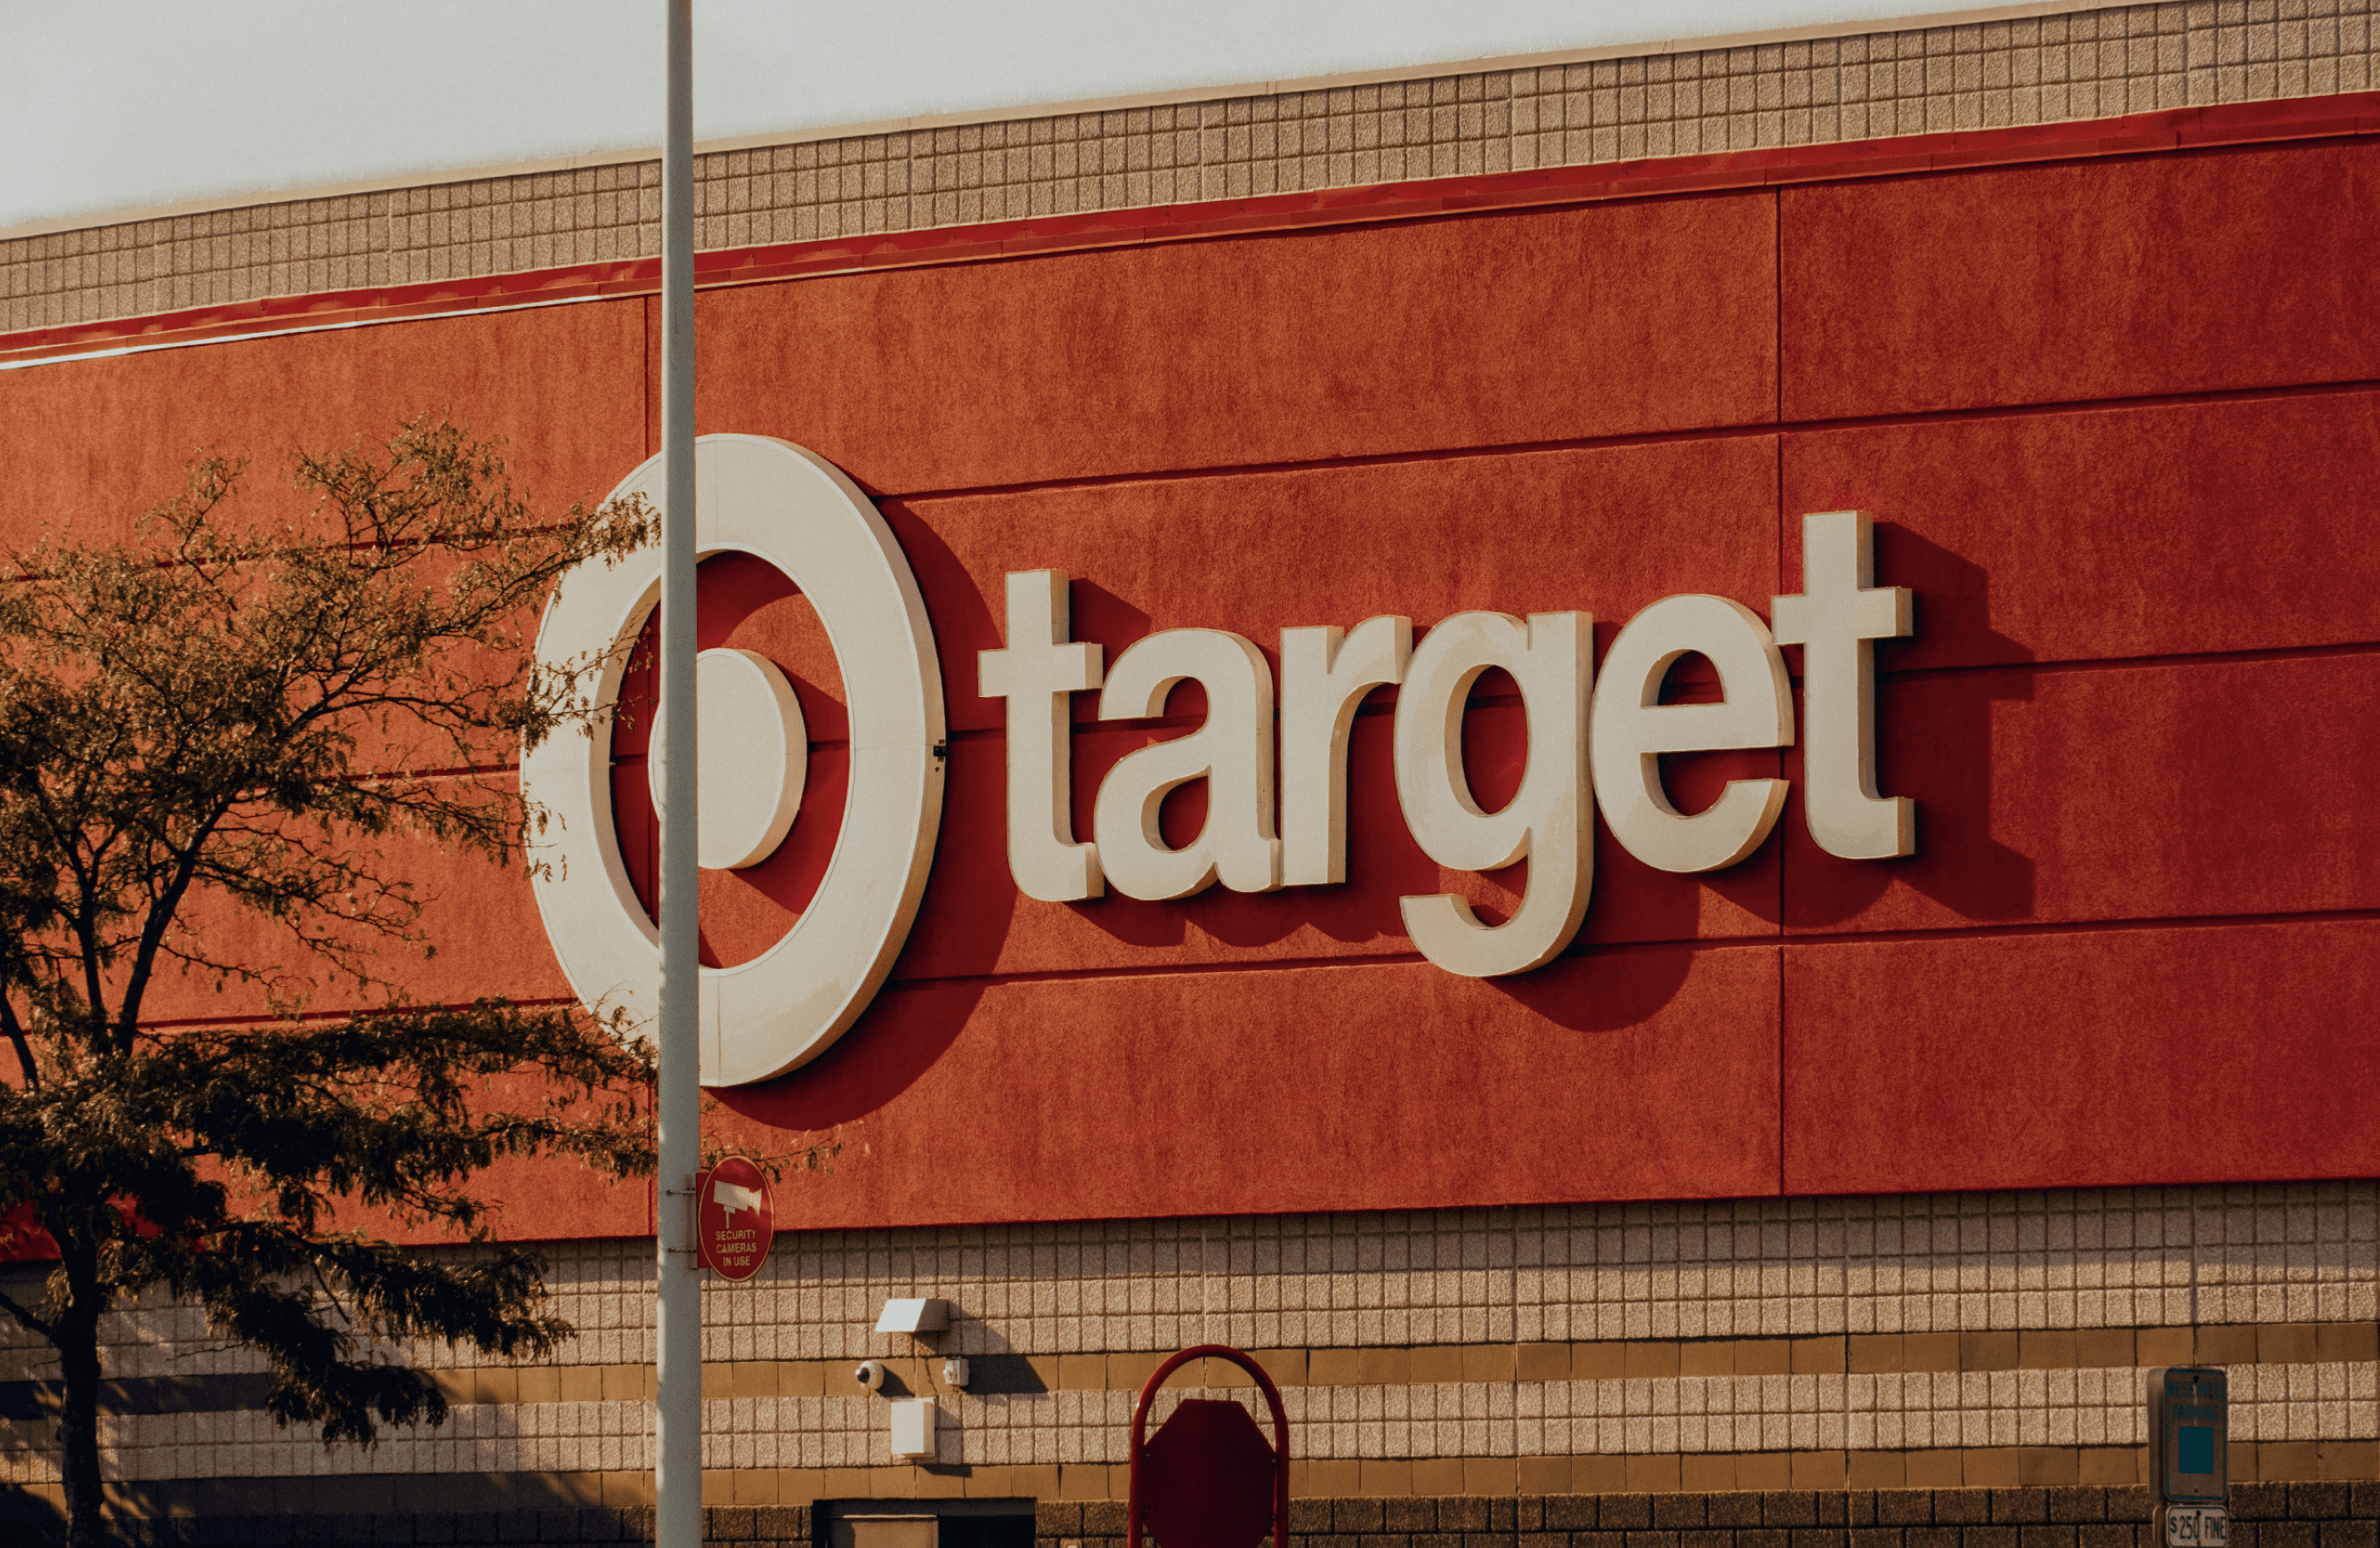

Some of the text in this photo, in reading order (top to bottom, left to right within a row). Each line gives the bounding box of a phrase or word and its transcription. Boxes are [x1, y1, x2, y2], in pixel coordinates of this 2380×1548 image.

[977, 509, 1915, 977] target
[715, 1229, 757, 1241] SECURITY
[716, 1242, 757, 1254] CAMERAS
[723, 1255, 751, 1268] IN USE
[2205, 1516, 2227, 1540] FINE
